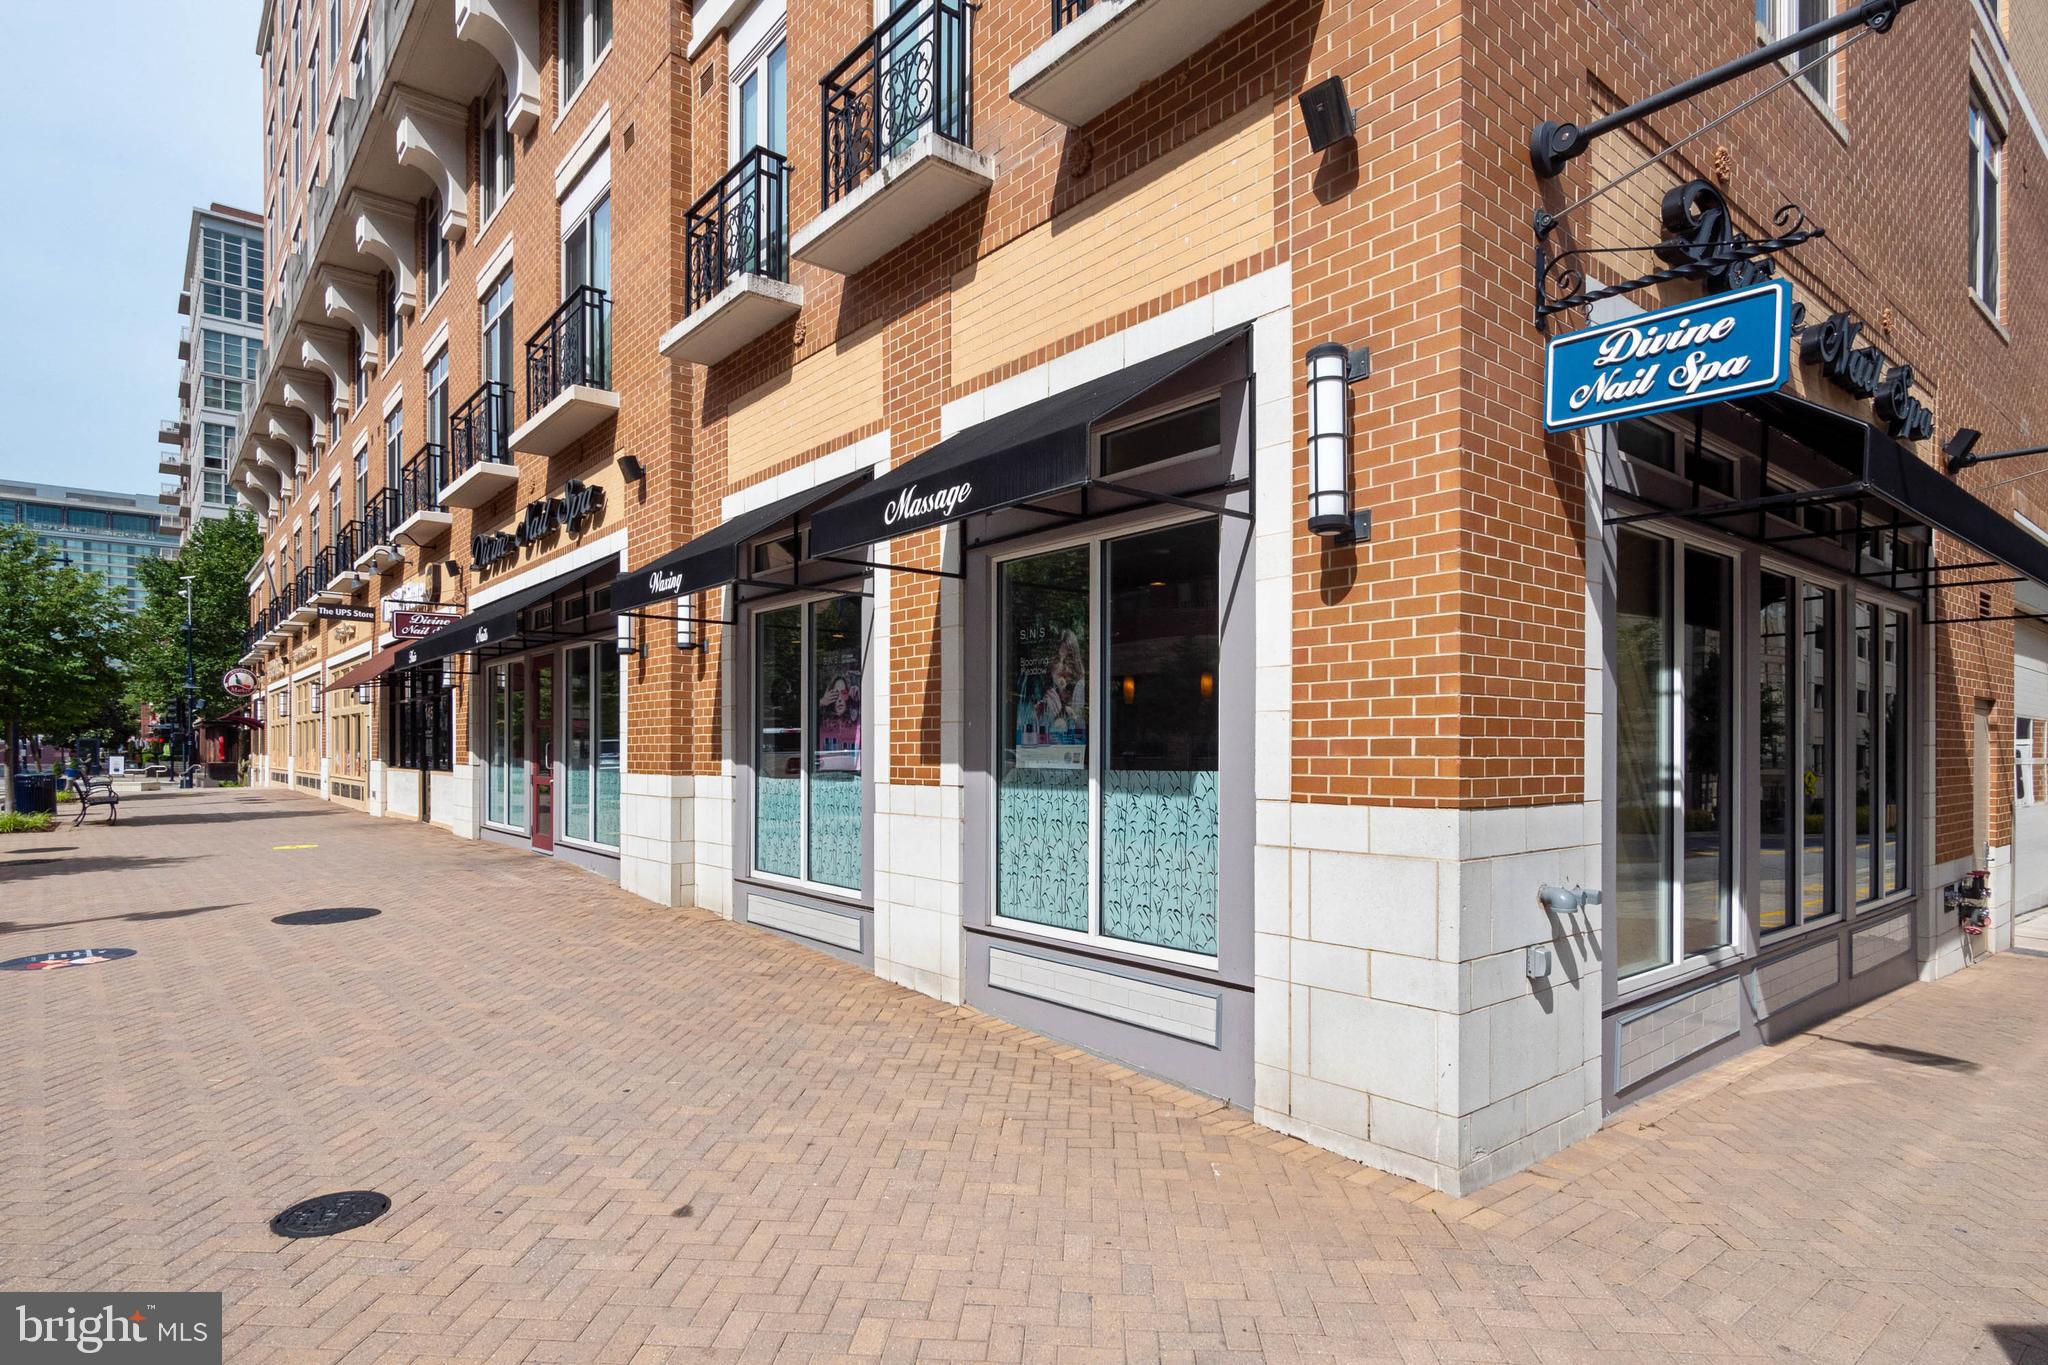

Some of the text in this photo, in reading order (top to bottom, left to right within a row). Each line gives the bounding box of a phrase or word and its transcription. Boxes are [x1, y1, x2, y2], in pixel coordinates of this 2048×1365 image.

[1593, 316, 1736, 367] Divine
[1569, 350, 1751, 410] Nail Spa
[1872, 364, 1934, 441] Spa
[557, 478, 604, 533] Spa
[884, 482, 973, 525] Massage
[649, 570, 683, 594] Waxing
[318, 606, 375, 618] The UPS Store
[401, 624, 430, 635] Nail
[409, 614, 451, 626] Divine
